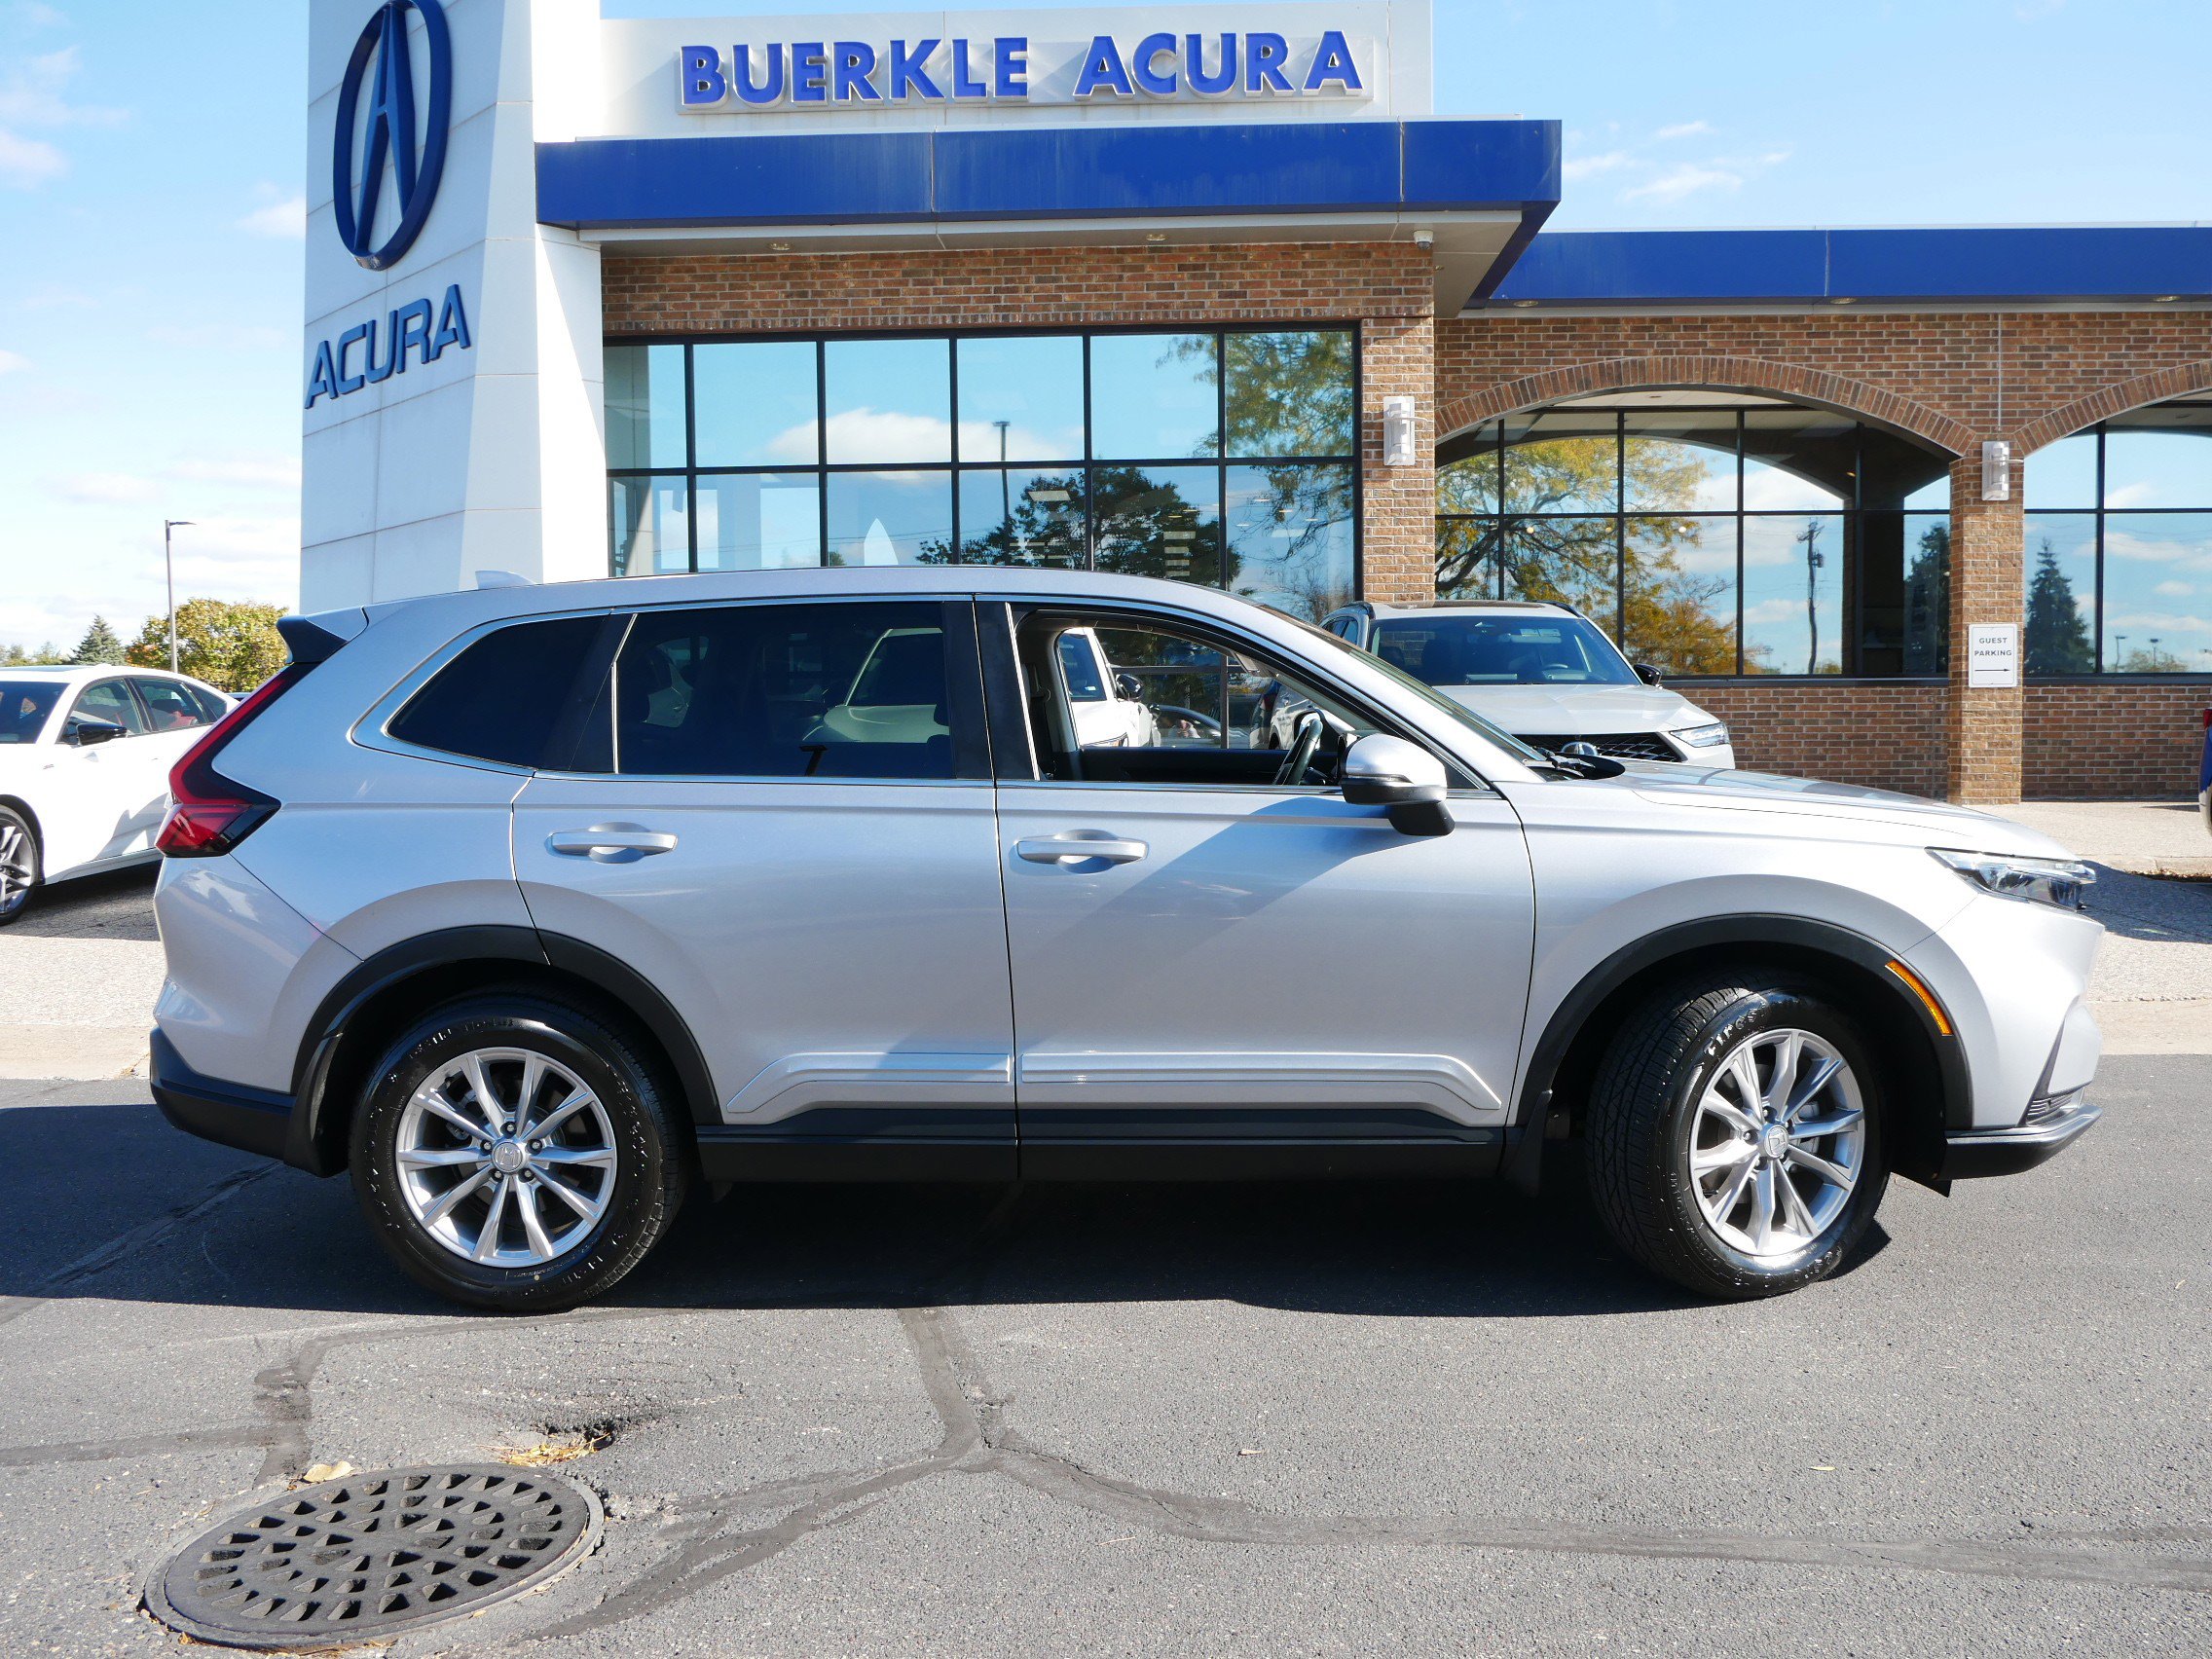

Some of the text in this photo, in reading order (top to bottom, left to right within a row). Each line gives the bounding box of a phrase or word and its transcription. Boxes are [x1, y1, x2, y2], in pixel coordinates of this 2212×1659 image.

[680, 30, 1363, 107] BUERKLE ACURA
[304, 283, 471, 410] ACURA
